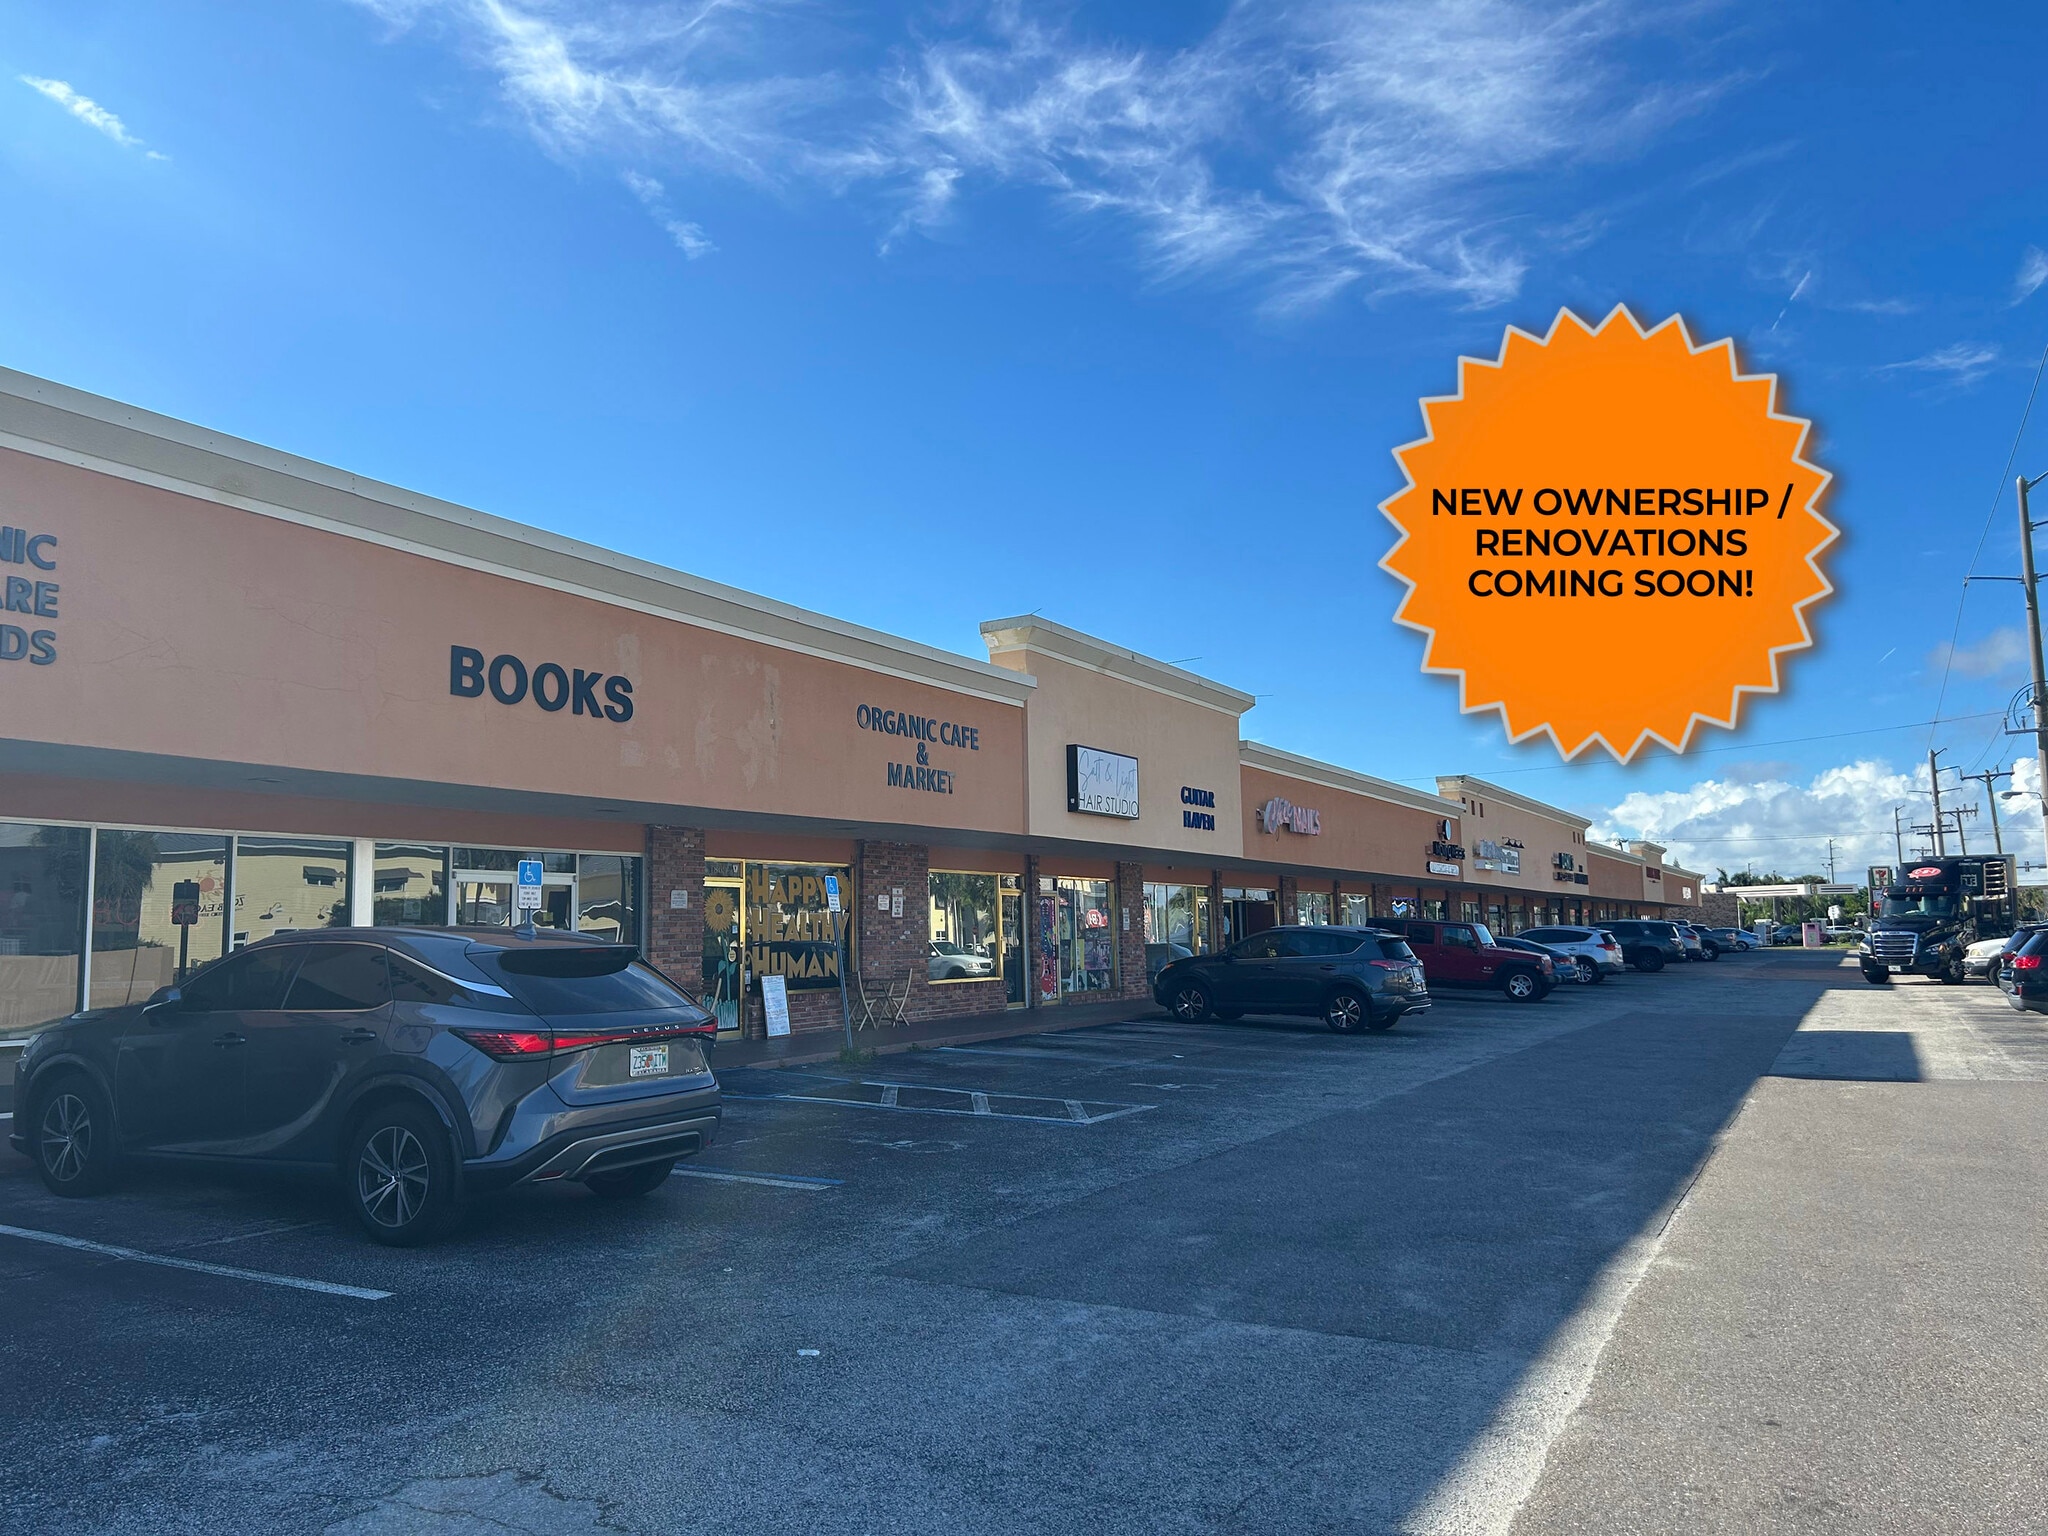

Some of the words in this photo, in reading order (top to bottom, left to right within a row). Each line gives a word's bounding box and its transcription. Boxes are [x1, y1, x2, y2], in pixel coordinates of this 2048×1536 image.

[451, 644, 634, 723] BOOKS
[856, 704, 937, 742] ORGANIC
[940, 722, 979, 750] CAFE
[916, 742, 929, 766] &
[887, 762, 956, 794] MARKET
[1078, 792, 1103, 812] HAIR
[1105, 796, 1138, 817] STUDIO
[1181, 786, 1215, 808] GUITAR
[1183, 810, 1215, 831] HAVEN
[752, 868, 828, 904] HAPPY
[751, 907, 850, 942] HEALTHY
[751, 946, 839, 979] HUMAN
[632, 1024, 679, 1034] LEXUS
